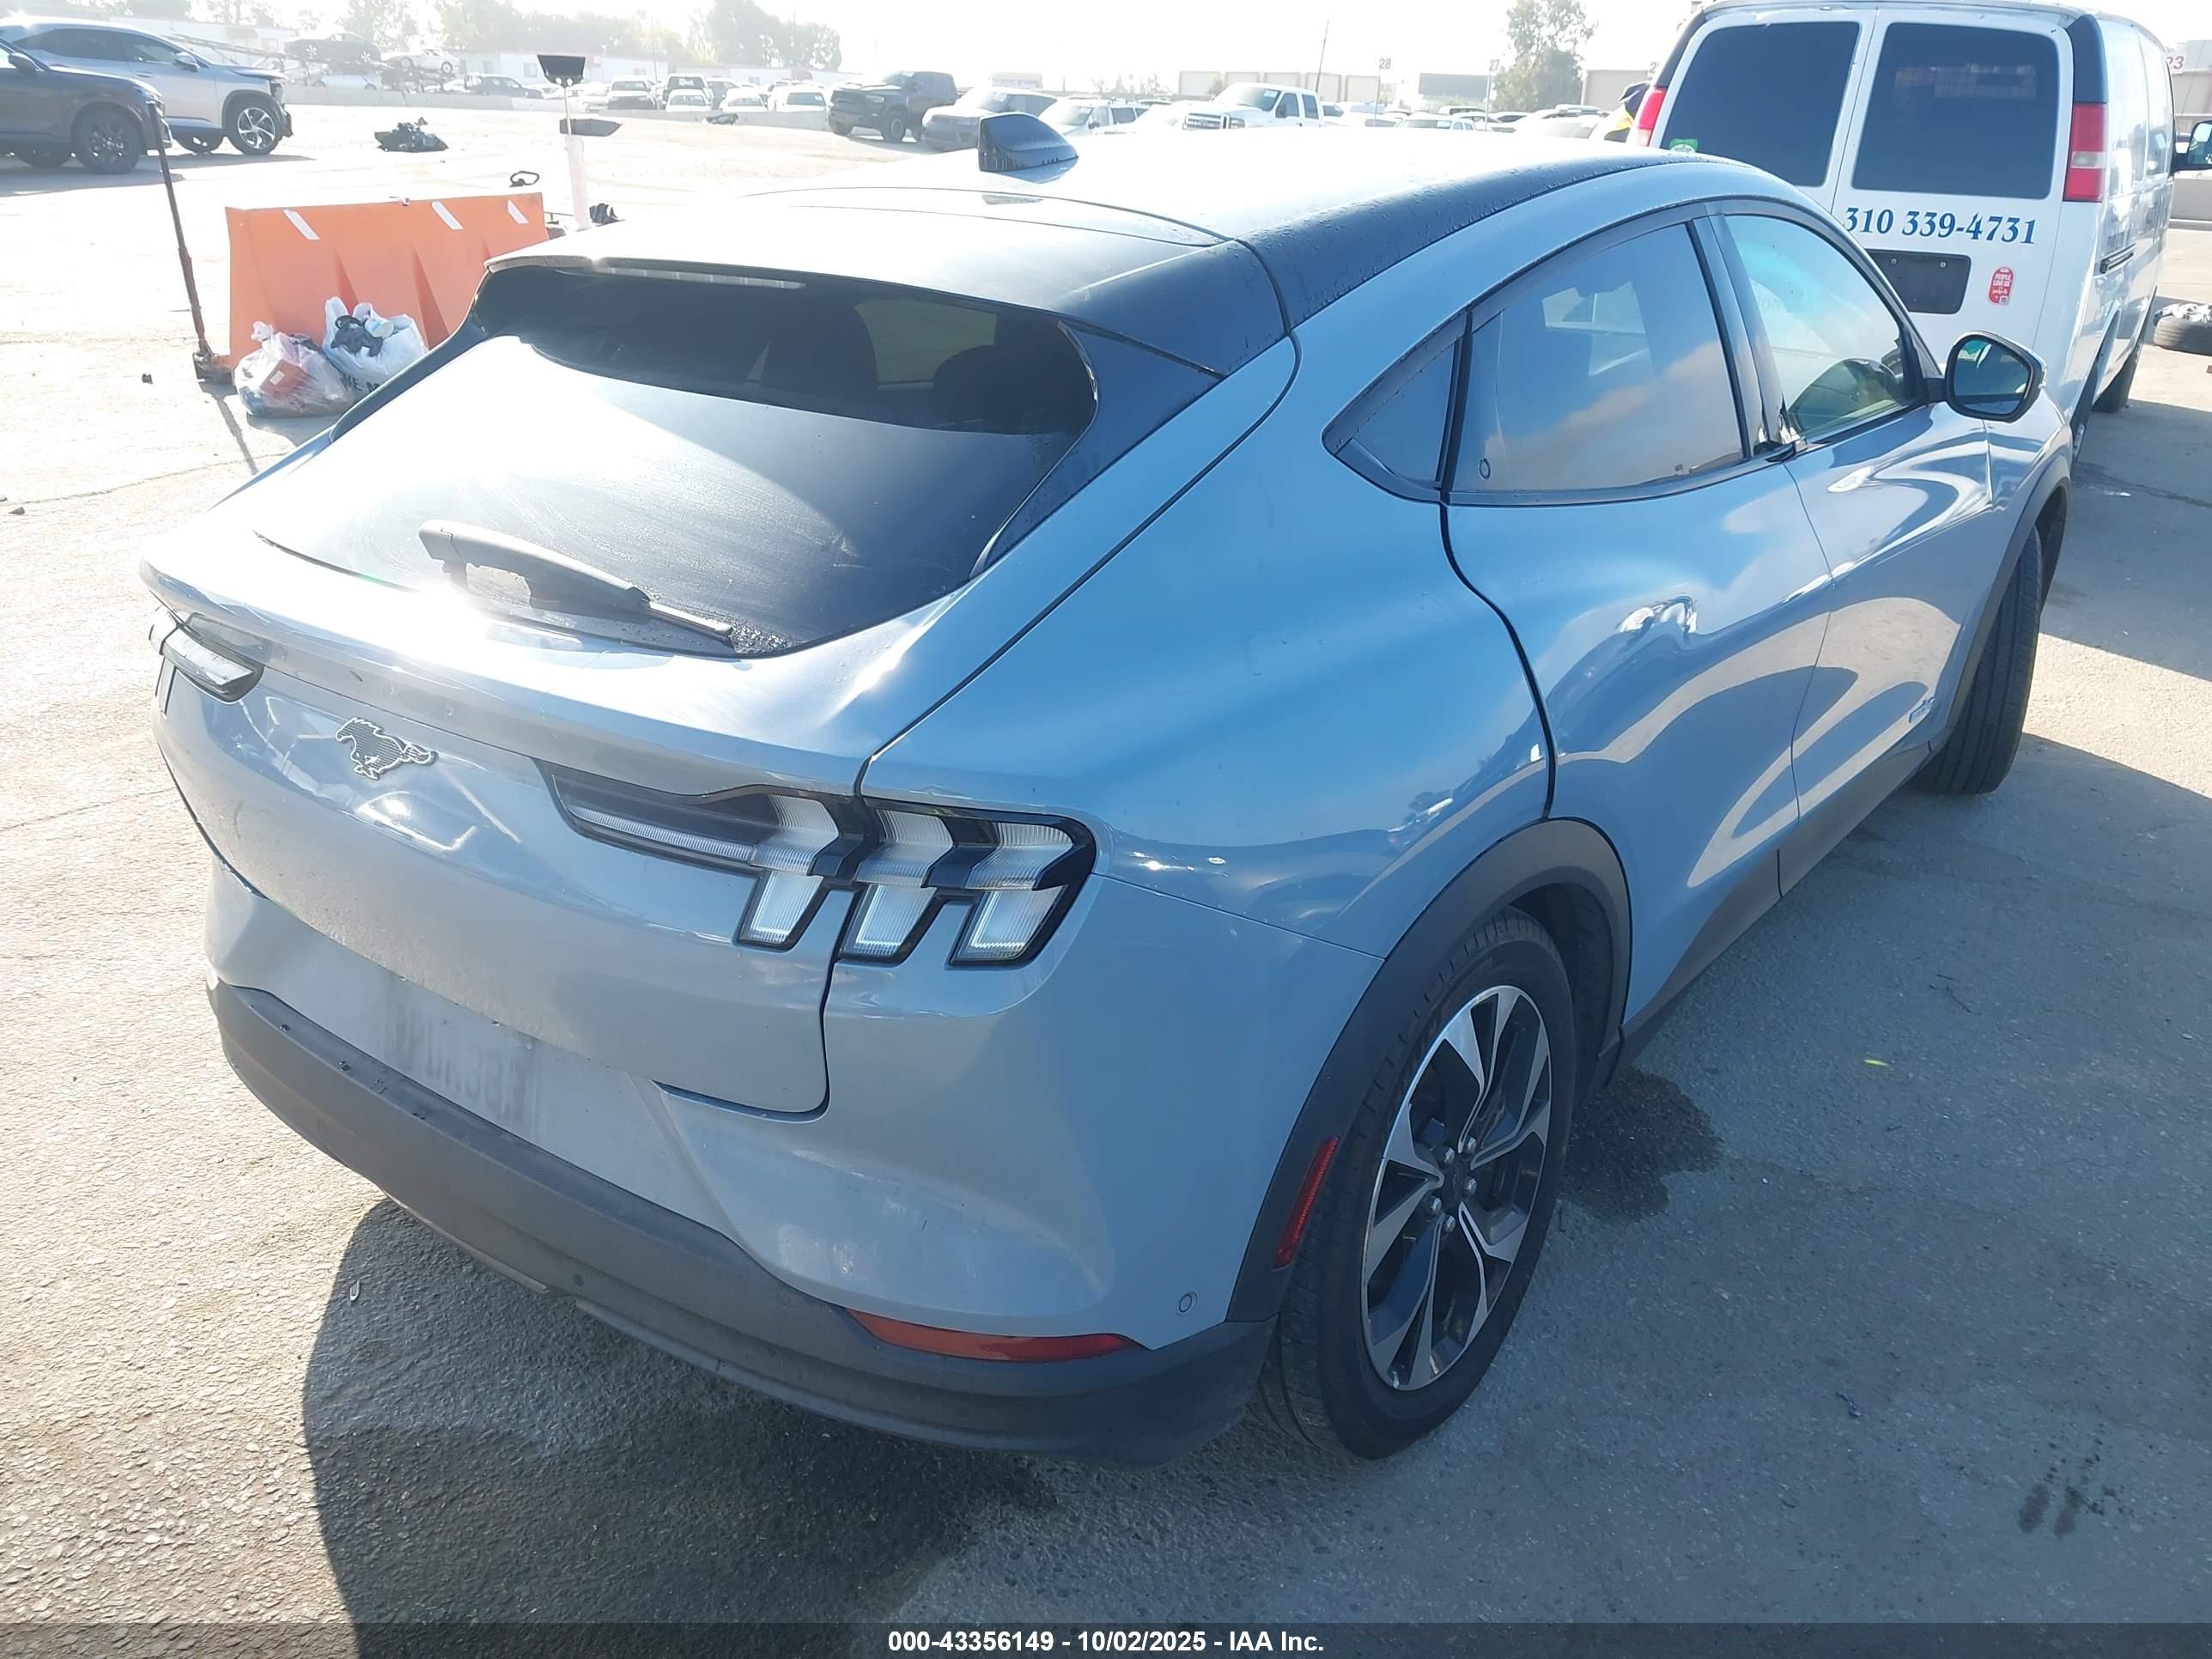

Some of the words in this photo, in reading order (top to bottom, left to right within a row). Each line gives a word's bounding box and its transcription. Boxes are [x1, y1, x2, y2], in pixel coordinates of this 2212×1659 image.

[1379, 58, 1391, 69] 28
[1489, 59, 1499, 70] 27
[1844, 207, 1893, 234] 310
[1901, 210, 2036, 245] 339-4731
